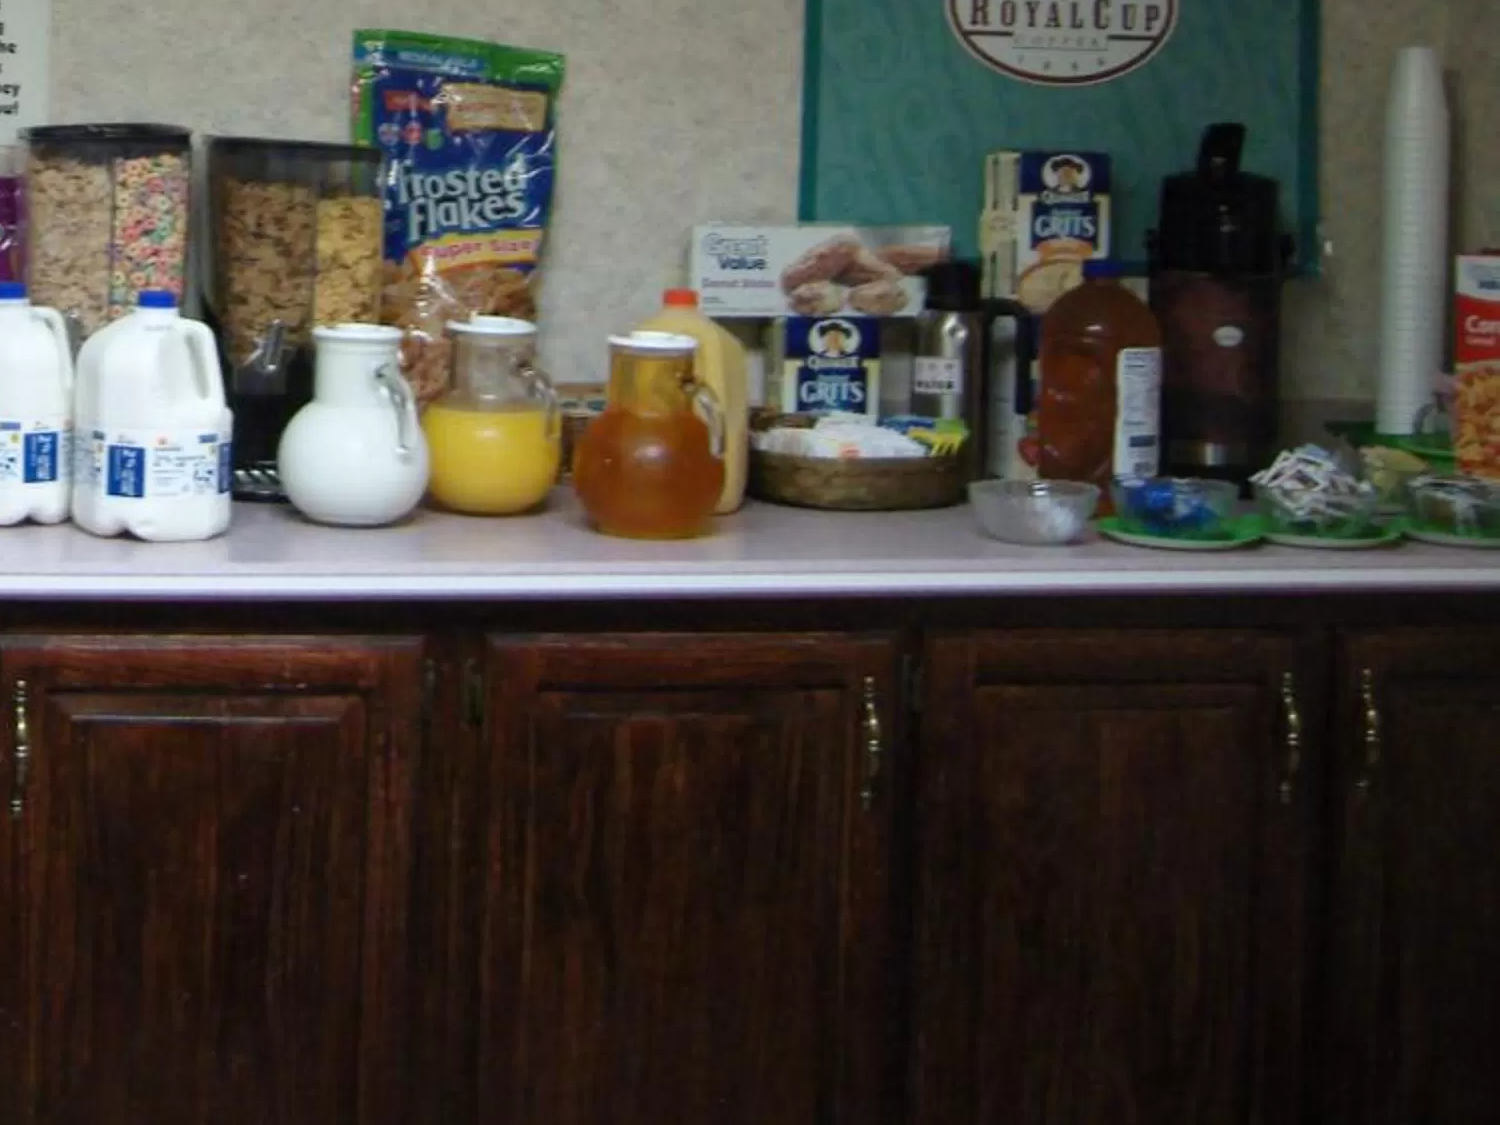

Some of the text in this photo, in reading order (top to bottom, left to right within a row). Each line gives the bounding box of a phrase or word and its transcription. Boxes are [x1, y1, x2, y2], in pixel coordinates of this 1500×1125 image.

[1035, 214, 1096, 239] GRITS
[717, 255, 766, 271] Value
[800, 380, 864, 406] GRITS
